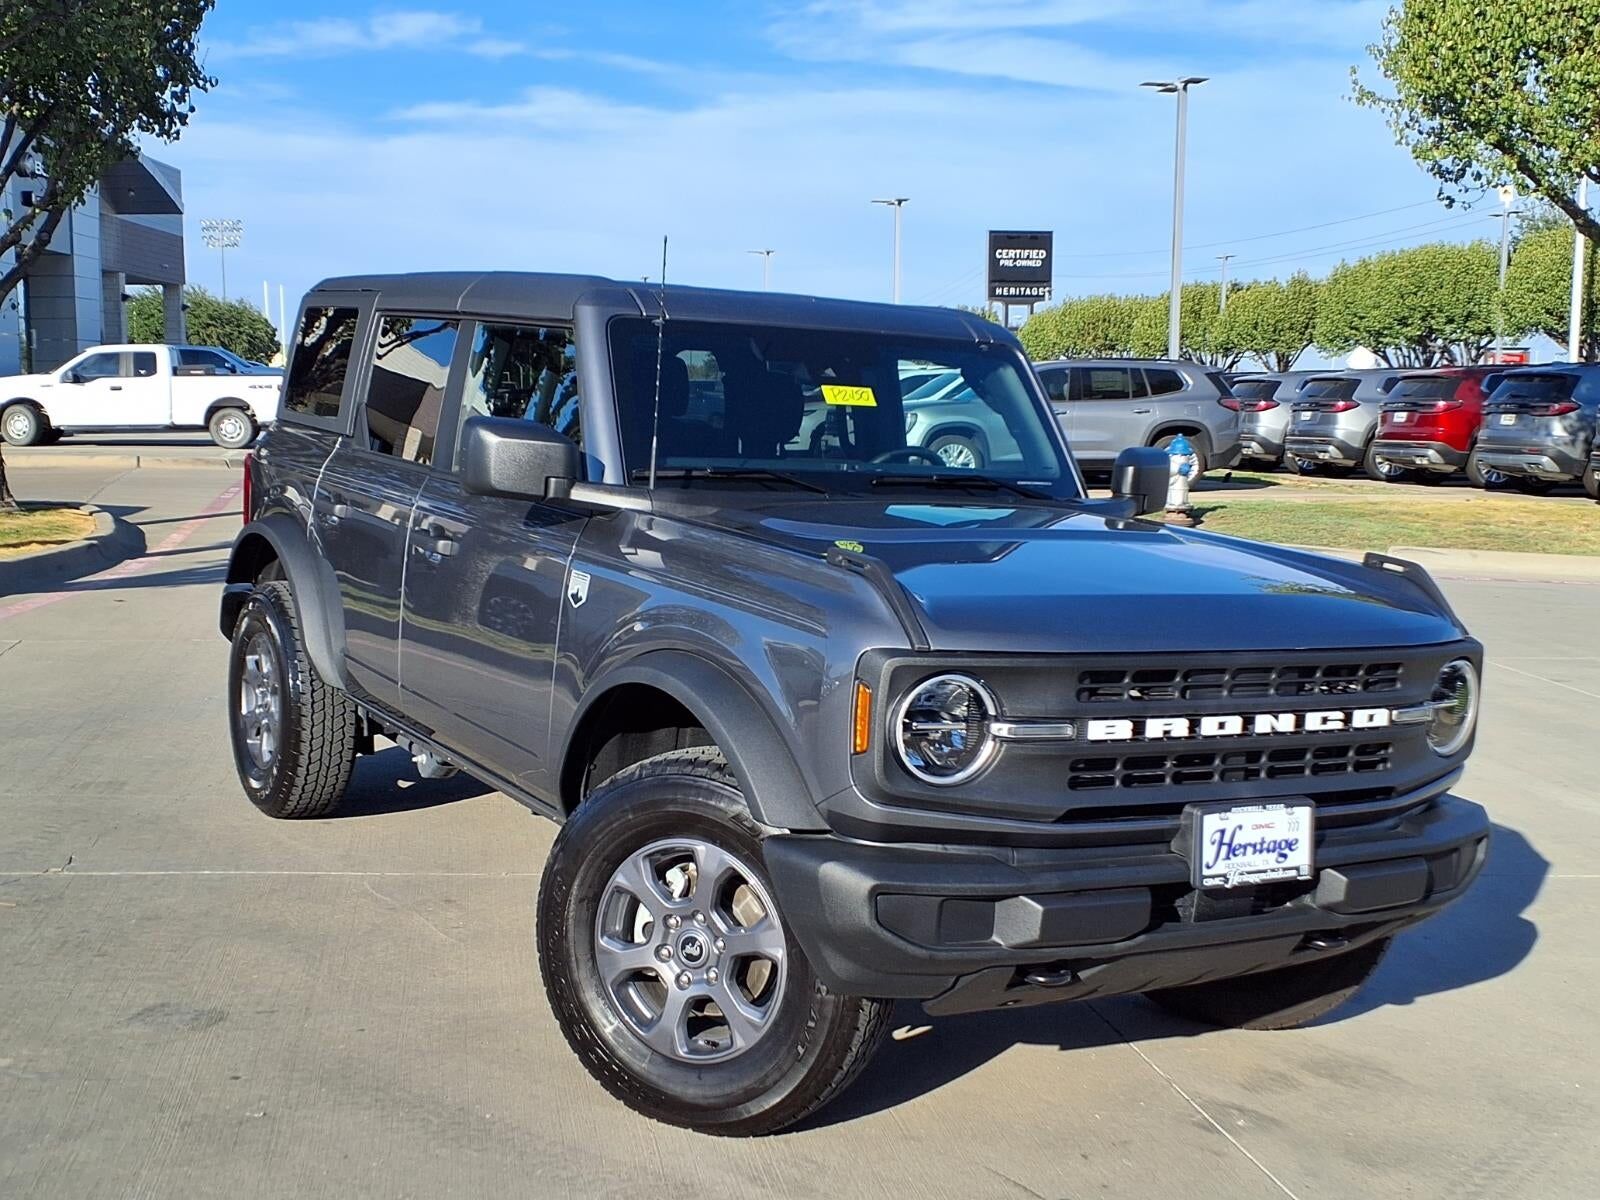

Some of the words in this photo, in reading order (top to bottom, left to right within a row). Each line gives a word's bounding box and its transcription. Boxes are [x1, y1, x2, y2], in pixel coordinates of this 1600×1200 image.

[995, 249, 1047, 259] CERTIFIED
[1000, 259, 1042, 267] PRE-OWNED
[995, 287, 1044, 296] HERITAGE
[1087, 709, 1390, 740] BRONCO
[1251, 822, 1276, 830] GMC
[1205, 824, 1299, 870] Heritage
